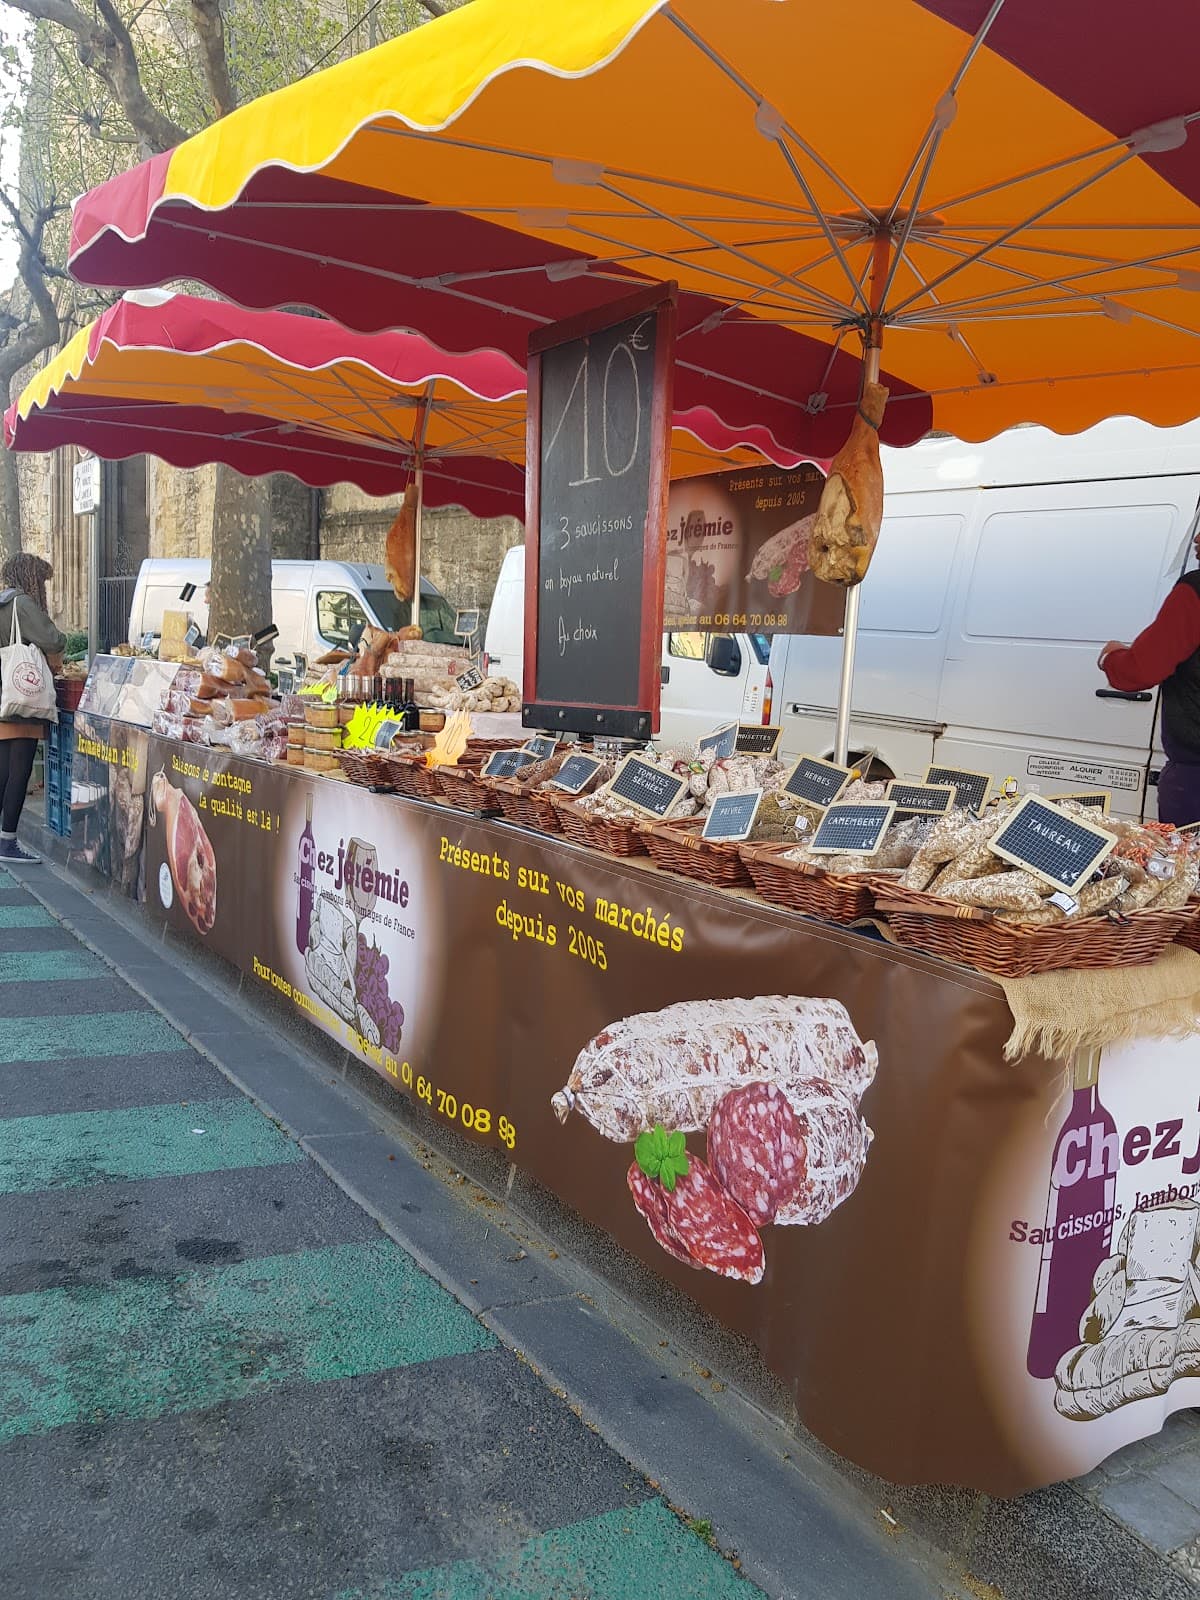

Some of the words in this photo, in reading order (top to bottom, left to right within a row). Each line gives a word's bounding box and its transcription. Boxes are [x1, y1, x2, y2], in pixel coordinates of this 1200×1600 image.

[768, 476, 783, 487] sur
[755, 496, 783, 511] depuis
[786, 492, 806, 506] 2005
[560, 516, 570, 549] 3
[576, 515, 632, 538] saucissons
[586, 558, 619, 583] naturel
[573, 618, 598, 641] choix
[699, 614, 712, 625] au
[714, 613, 730, 626] 06
[733, 613, 747, 626] 64
[750, 613, 762, 626] 70
[764, 613, 776, 626] 08
[777, 613, 788, 627] 98
[638, 766, 670, 788] TOMATES
[804, 770, 832, 787] HERBES
[1069, 765, 1103, 776] ALQUIER
[246, 808, 258, 826] est
[827, 816, 883, 827] CAMEMBERT
[1028, 818, 1082, 854] TAUREAU
[334, 838, 409, 909] jérémie
[439, 837, 511, 881] Présents
[517, 867, 550, 895] sur
[555, 881, 585, 913] vos
[595, 897, 685, 952] marchés
[383, 914, 393, 928] de
[495, 900, 557, 947] depuis
[568, 925, 608, 971] 2005
[416, 1075, 433, 1106] 64
[436, 1088, 458, 1119] 70
[461, 1103, 492, 1133] 08
[498, 1115, 516, 1149] 98
[1053, 1118, 1184, 1188] Chez
